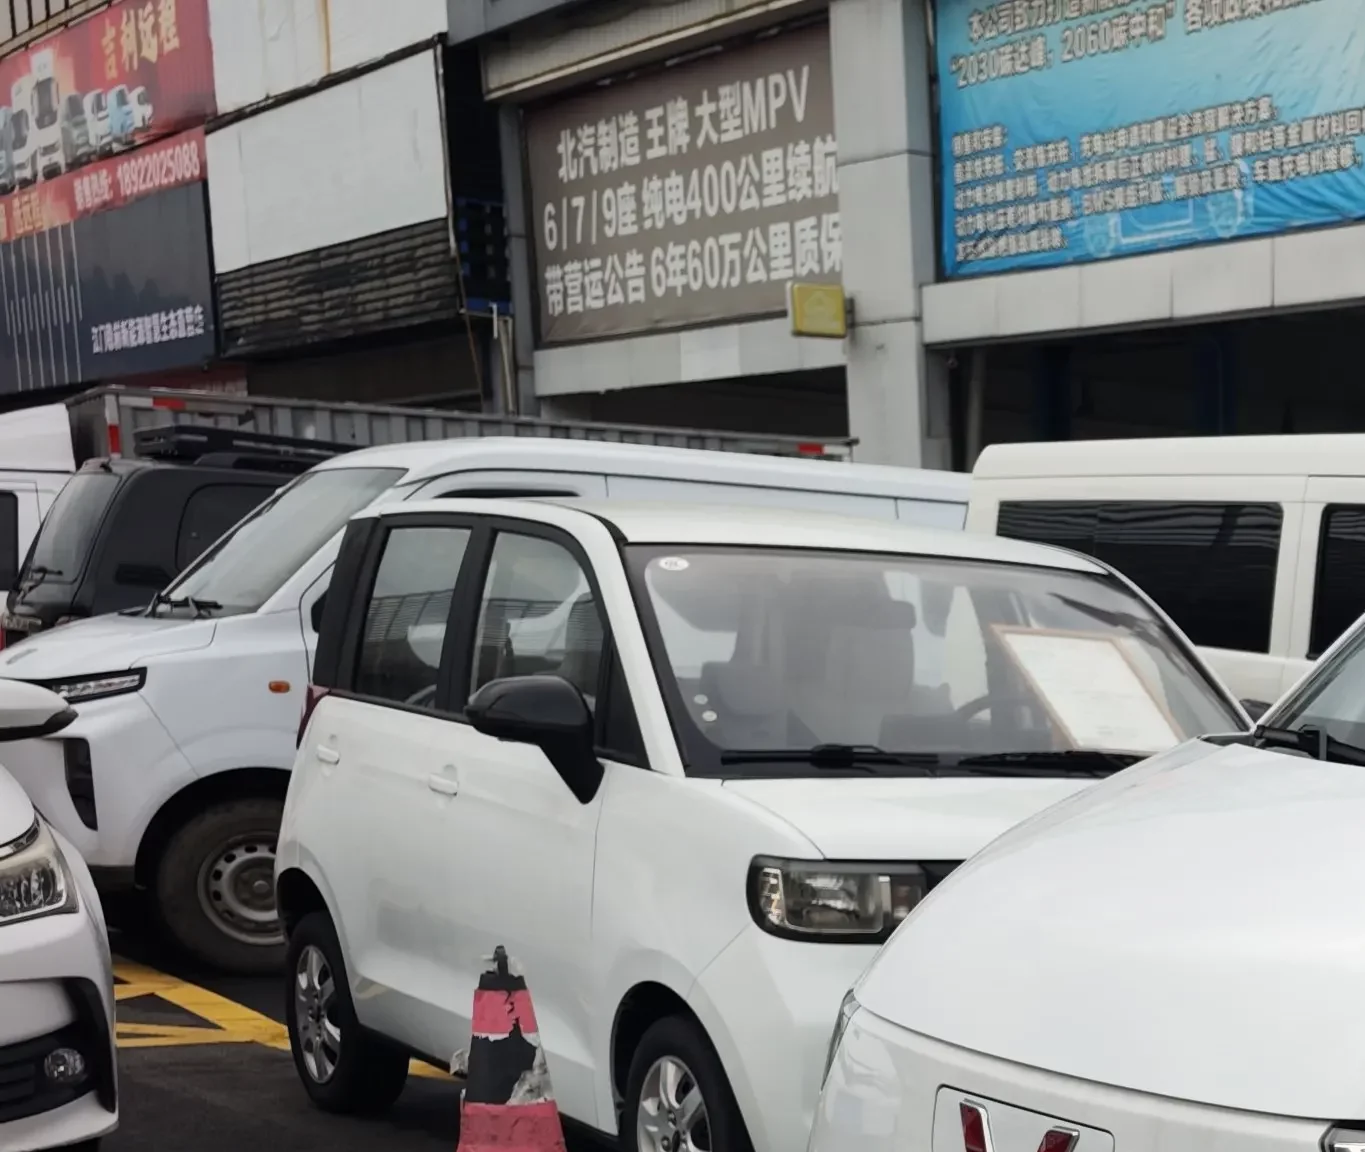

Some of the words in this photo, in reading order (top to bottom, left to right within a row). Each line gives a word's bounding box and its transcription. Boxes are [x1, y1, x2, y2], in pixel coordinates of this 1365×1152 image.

[117, 140, 200, 198] 18922025088
[557, 110, 641, 184] 北汽制造
[644, 96, 690, 159] 王牌
[695, 64, 810, 147] 大型MPV
[641, 135, 840, 232] 纯电400公里续航
[544, 249, 646, 317] 带营运公告
[650, 214, 843, 298] 6年60万公里质保
